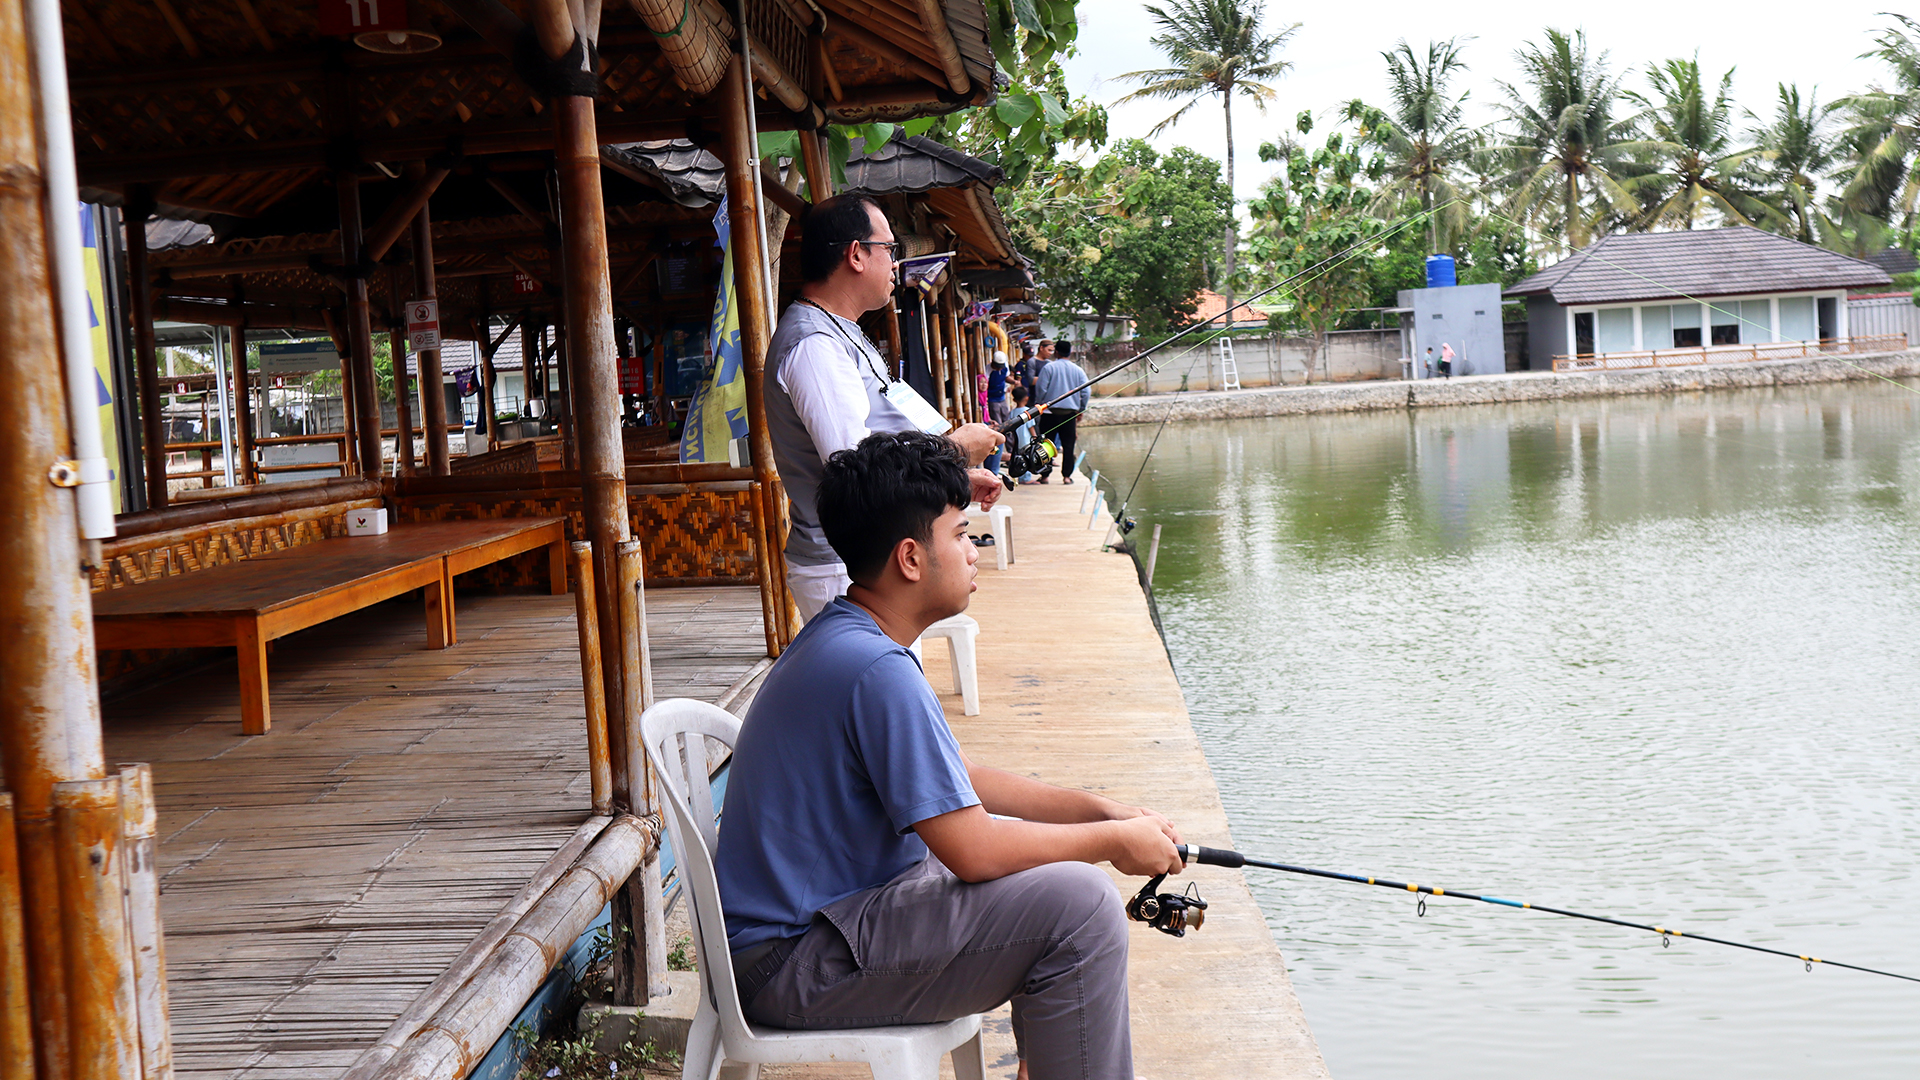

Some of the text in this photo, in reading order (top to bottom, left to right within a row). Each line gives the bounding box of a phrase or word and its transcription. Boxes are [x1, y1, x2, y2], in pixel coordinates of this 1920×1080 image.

[346, 0, 379, 27] 11
[521, 280, 534, 291] 14
[177, 382, 186, 394] 12
